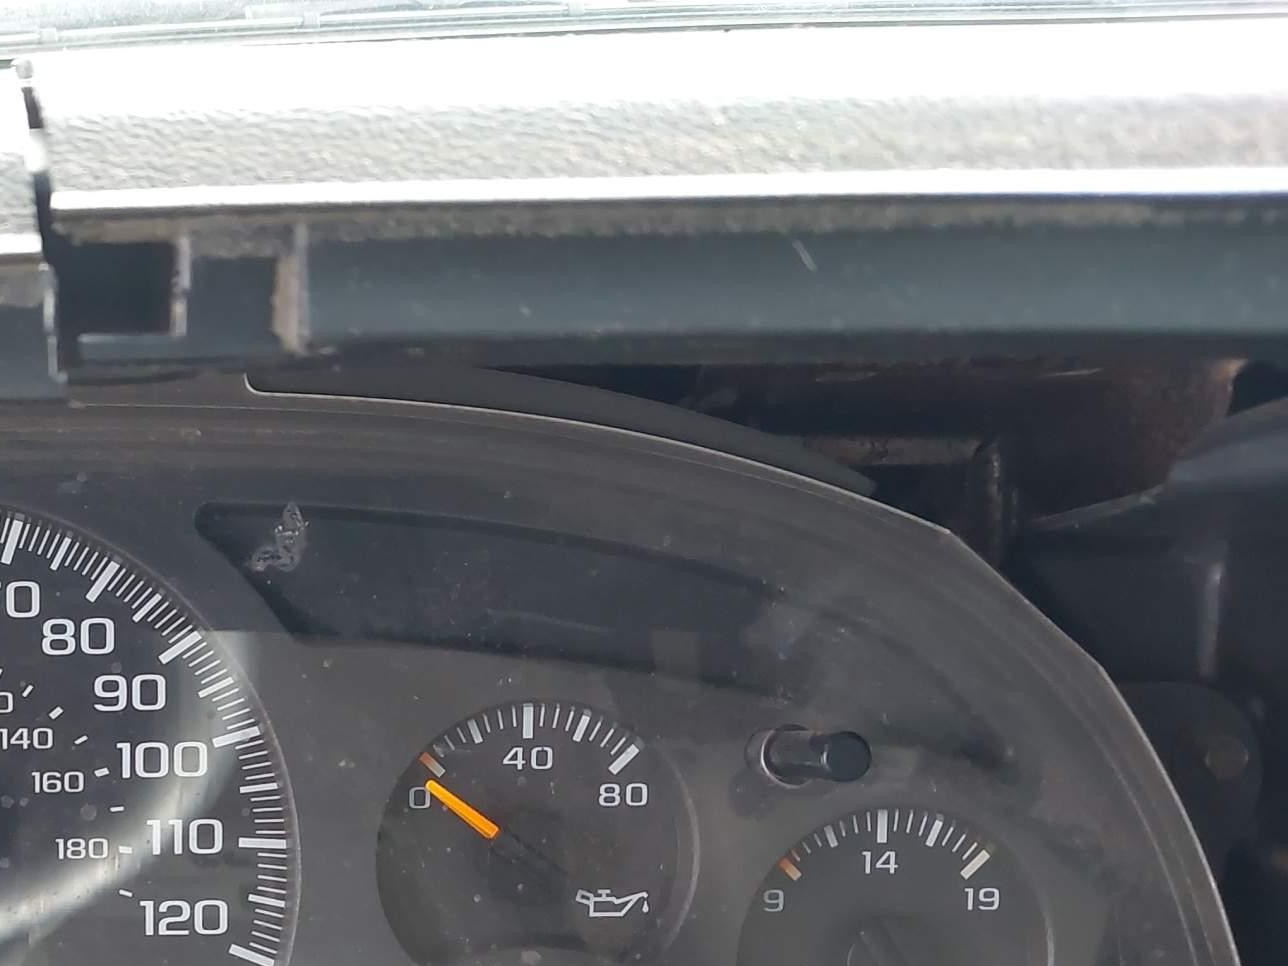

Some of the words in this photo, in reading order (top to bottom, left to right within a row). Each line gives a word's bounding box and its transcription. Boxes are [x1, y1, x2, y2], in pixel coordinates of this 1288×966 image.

[41, 617, 115, 656] 80
[93, 674, 166, 712] 90
[116, 741, 208, 779] 100
[502, 746, 553, 770] 40
[31, 771, 84, 794] 160
[409, 786, 431, 809] 0
[598, 783, 648, 807] 80
[55, 838, 109, 860] 180
[146, 819, 223, 855] 110
[861, 850, 899, 874] 14
[764, 889, 784, 912] 9
[964, 887, 1000, 911] 19
[139, 899, 228, 936] 120
